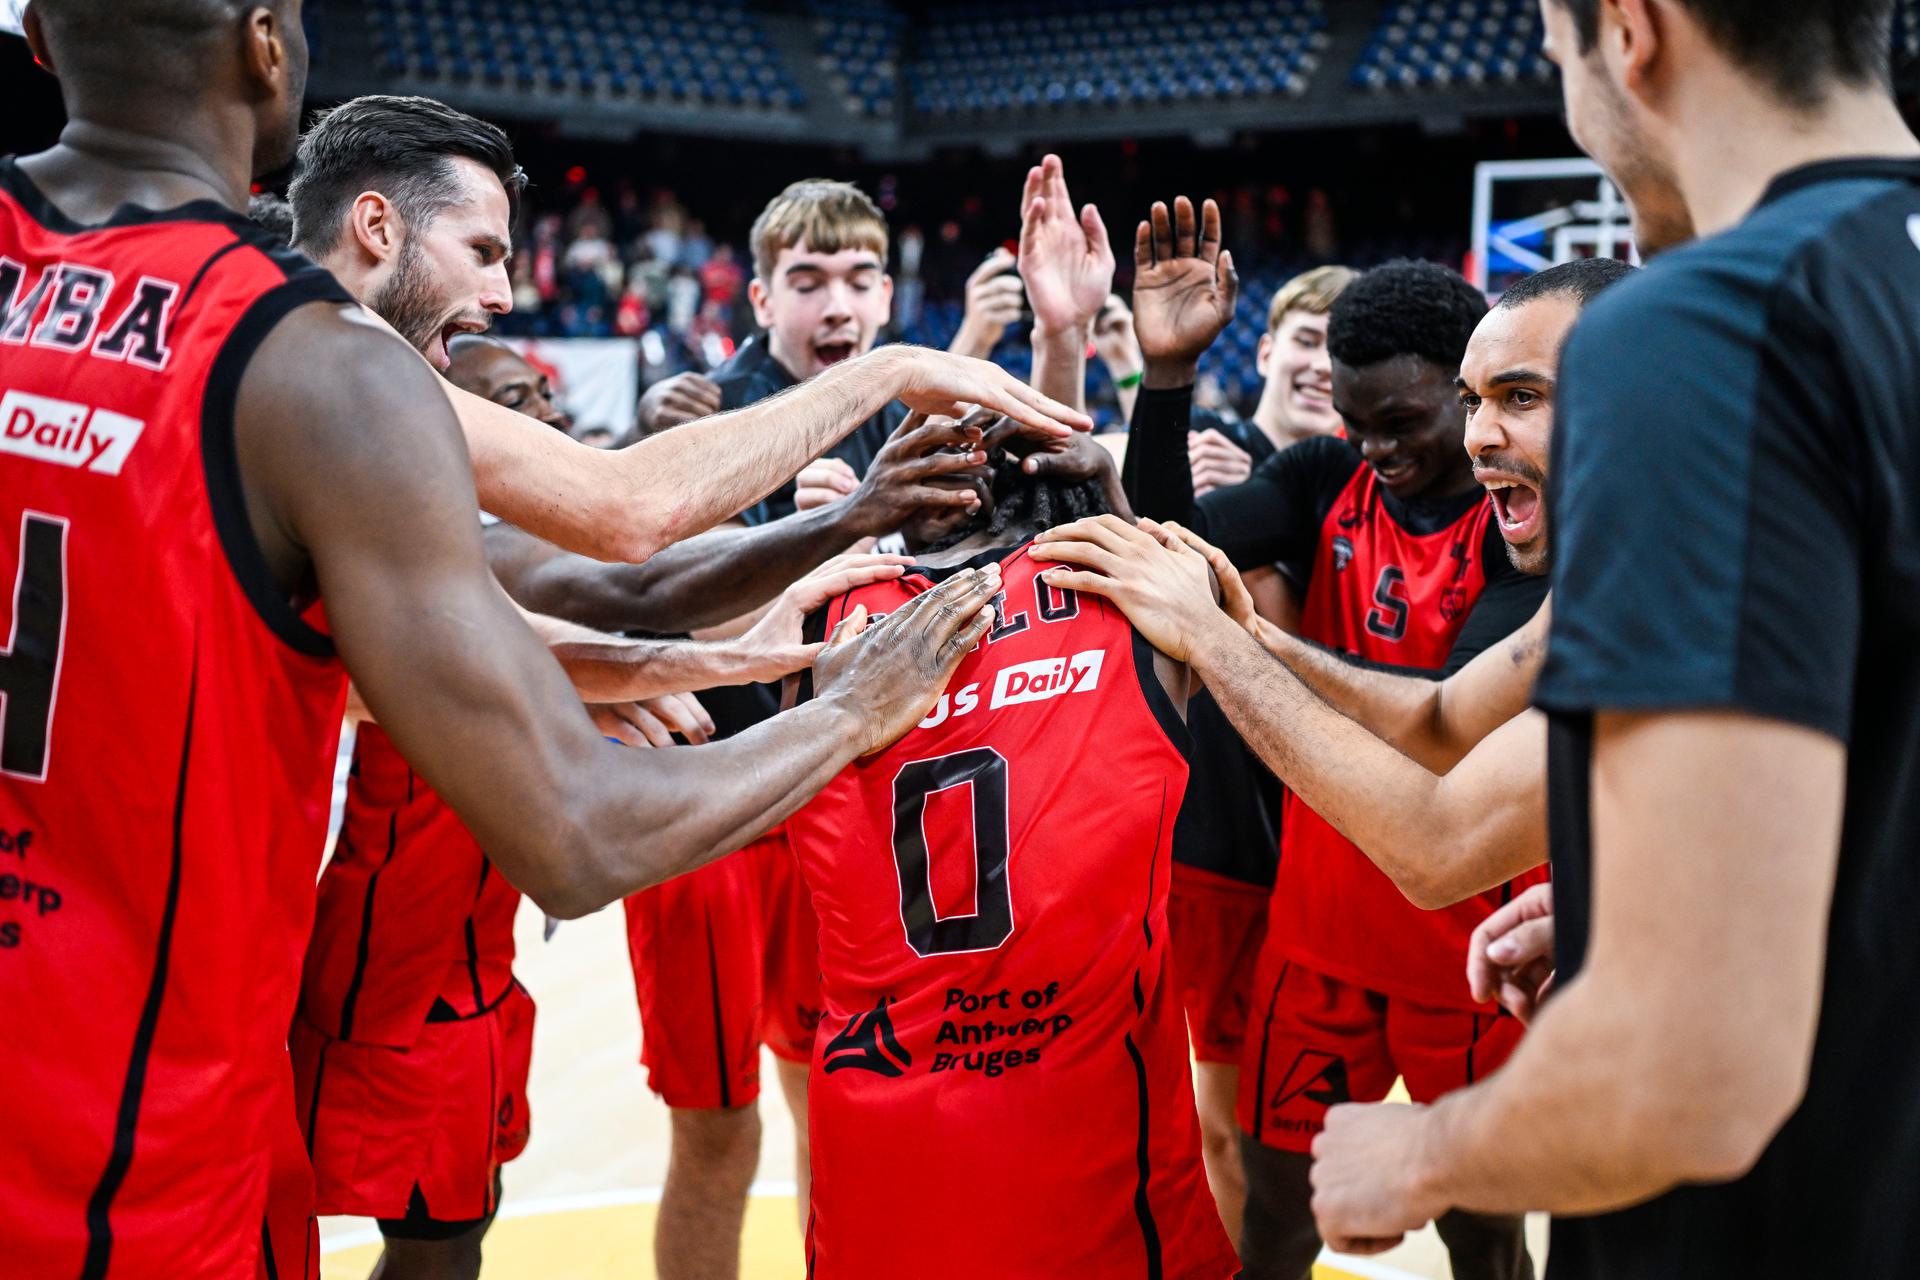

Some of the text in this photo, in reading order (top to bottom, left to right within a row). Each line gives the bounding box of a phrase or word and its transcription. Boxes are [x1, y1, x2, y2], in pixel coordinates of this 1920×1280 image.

[4, 405, 117, 460] Daily
[1004, 655, 1092, 699] Daily
[943, 982, 1060, 1013] Port of
[935, 1013, 1073, 1045] Antwerp
[930, 1048, 1041, 1077] Bruges
